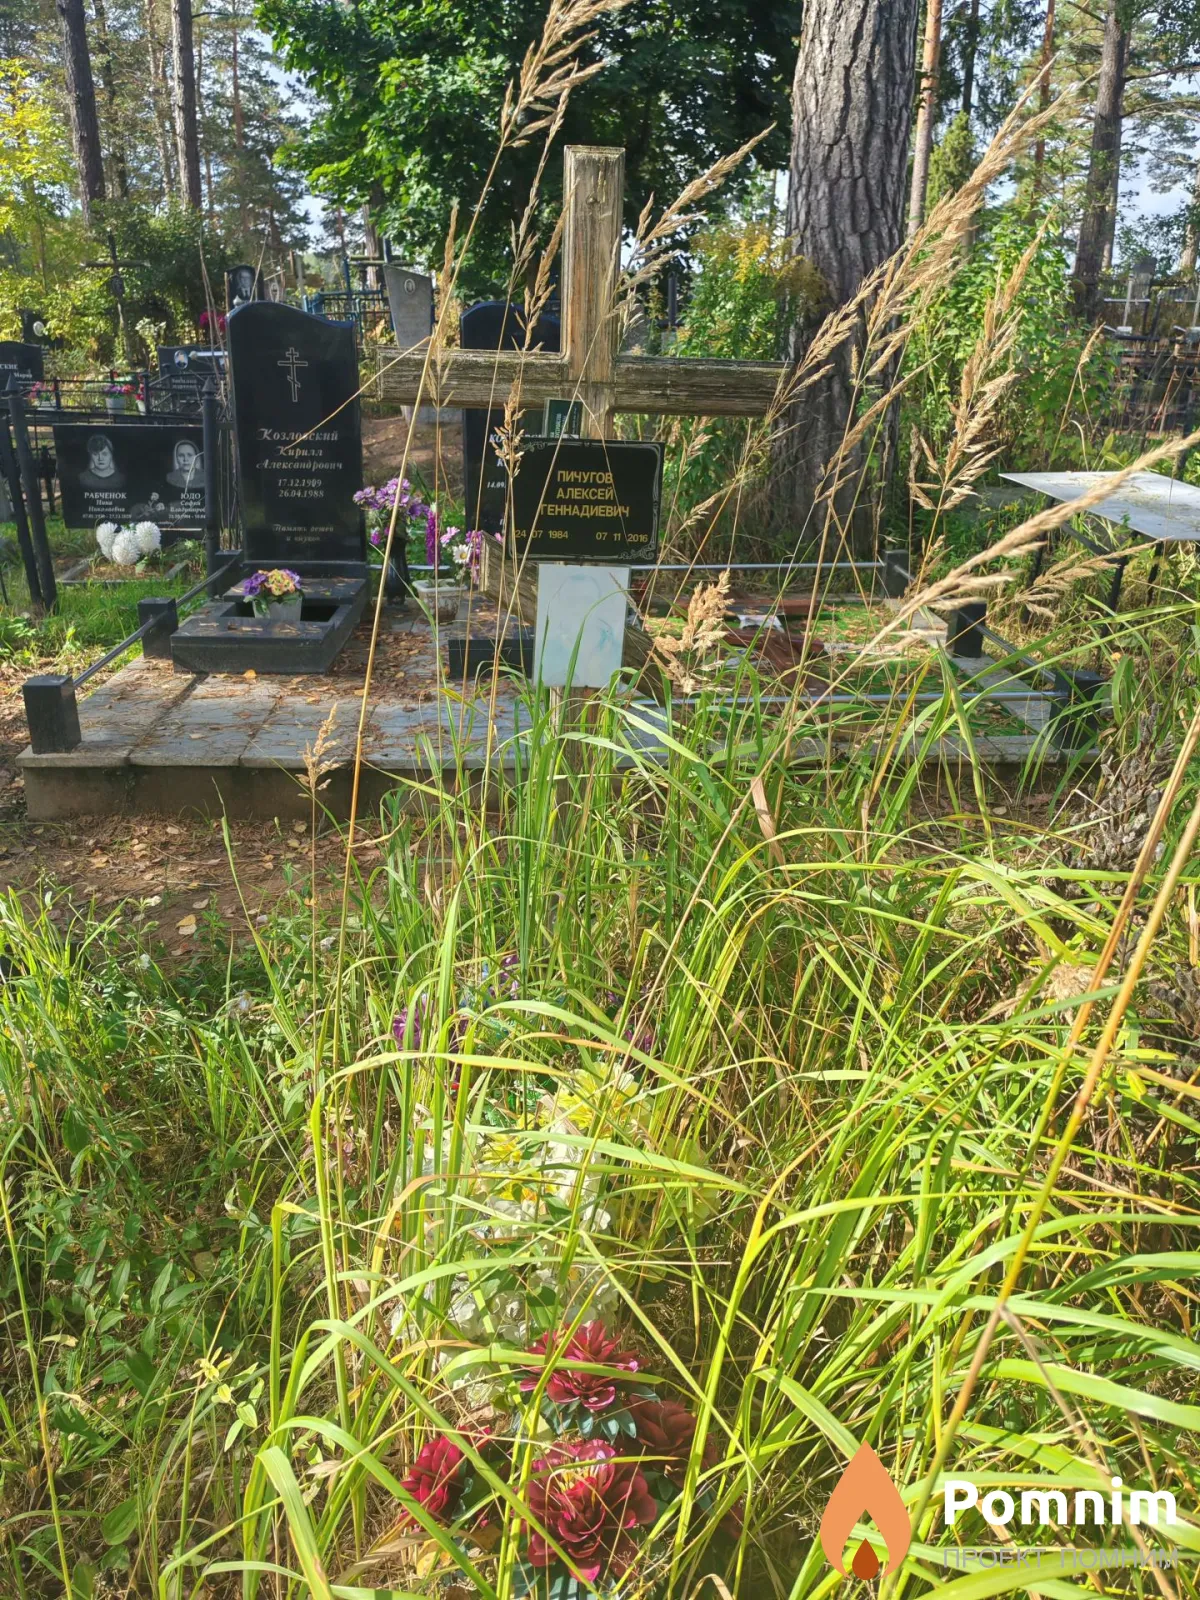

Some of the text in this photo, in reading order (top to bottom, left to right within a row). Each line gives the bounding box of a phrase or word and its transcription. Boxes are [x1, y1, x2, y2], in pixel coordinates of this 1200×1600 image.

[275, 445, 323, 458] Кирилл
[255, 459, 343, 472] Александрович
[557, 470, 613, 484] ПИЧУГОВ
[180, 492, 201, 500] ЮДО
[279, 489, 324, 499] 26.04.1988
[556, 486, 614, 500] АЛЕКСЕЙ
[539, 503, 630, 518] ГЕННАДИЕВИЧ
[515, 529, 569, 539] 24 07 1984
[596, 531, 649, 543] 07 11 2016
